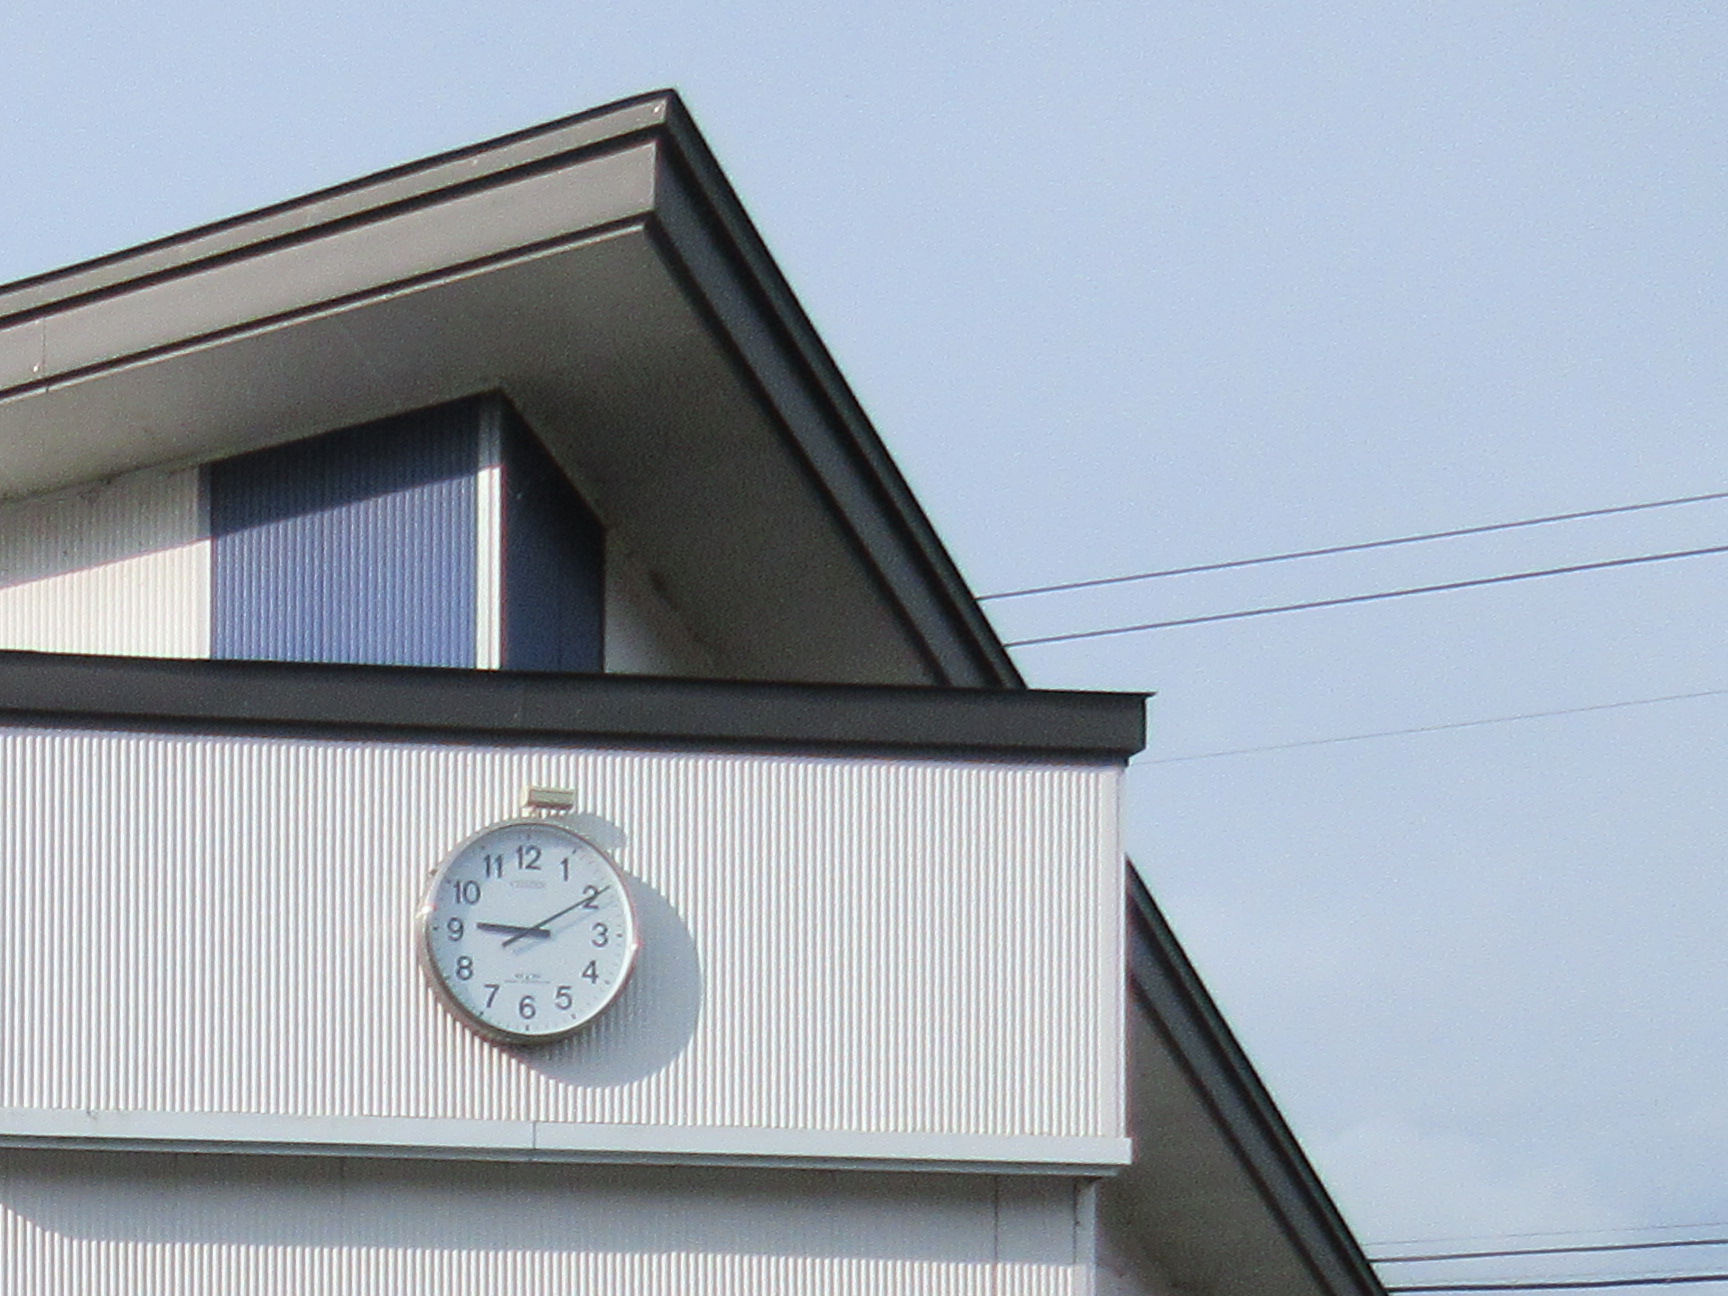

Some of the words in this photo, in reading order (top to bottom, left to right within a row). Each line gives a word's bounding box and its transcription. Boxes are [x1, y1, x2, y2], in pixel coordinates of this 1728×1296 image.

[483, 853, 503, 878] 11
[516, 845, 542, 870] 12
[560, 857, 569, 881] 1
[452, 880, 481, 905] 10
[582, 885, 600, 909] 2
[447, 917, 464, 941] 9
[592, 922, 608, 947] 3
[455, 955, 474, 981] 8
[582, 960, 599, 984] 4
[484, 984, 500, 1008] 7
[519, 995, 536, 1019] 6
[555, 985, 573, 1010] 5
